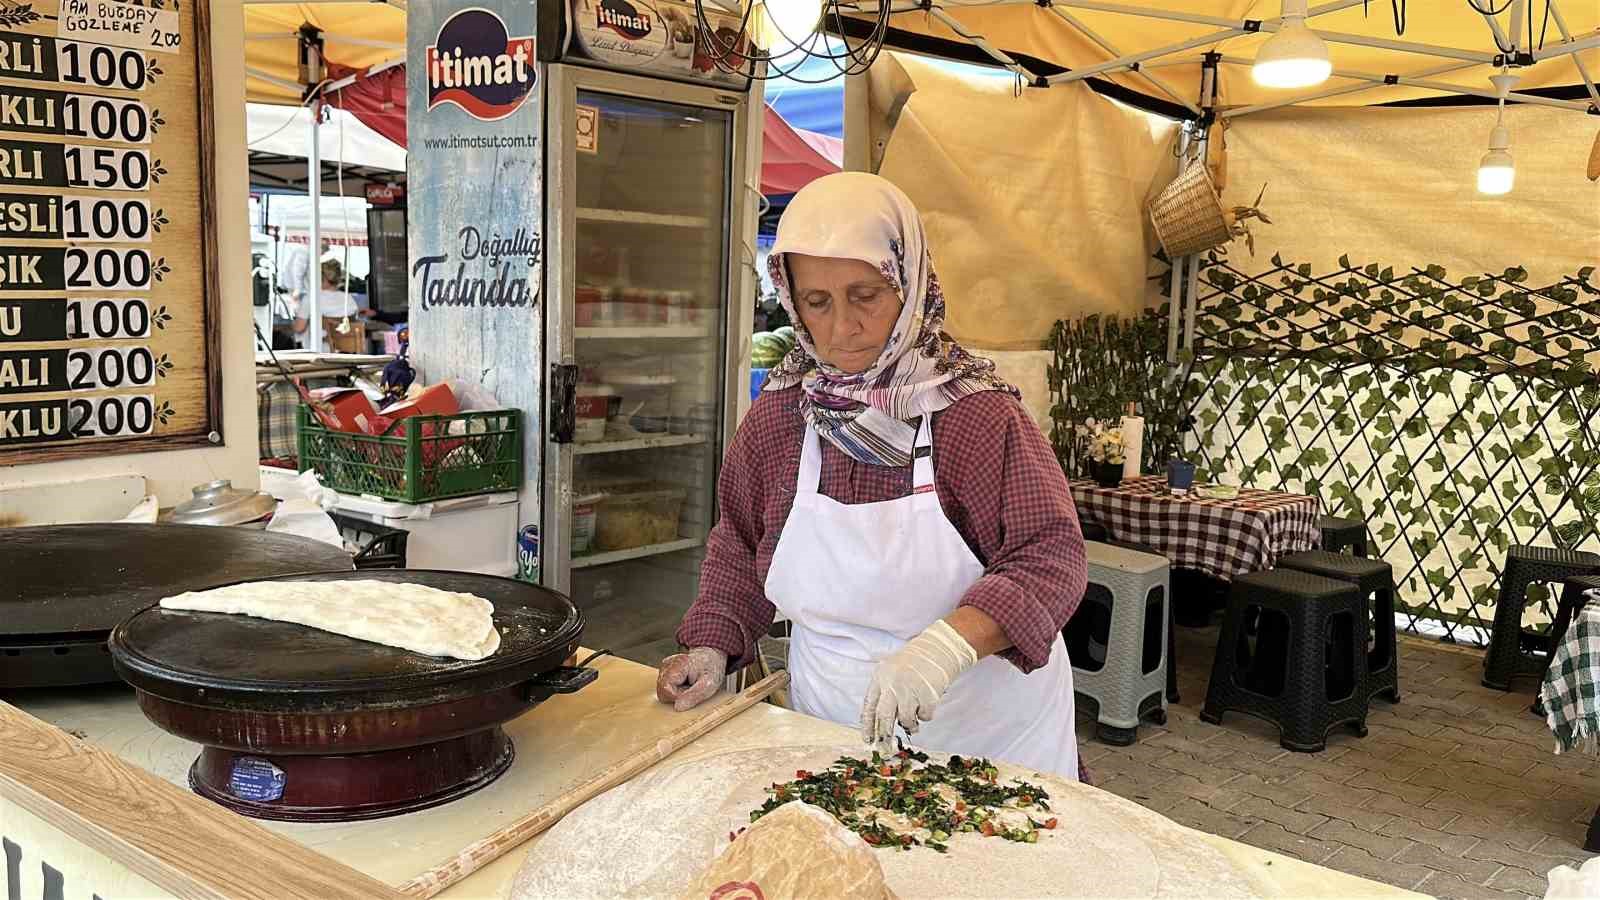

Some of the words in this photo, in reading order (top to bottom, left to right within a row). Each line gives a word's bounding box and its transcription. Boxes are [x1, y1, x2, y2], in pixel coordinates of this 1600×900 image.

[66, 16, 144, 33] GÖZLEME
[151, 29, 181, 47] 200
[599, 7, 649, 31] itimat
[62, 43, 145, 89] 100
[432, 45, 528, 88] itimat
[65, 97, 147, 142] 100
[425, 134, 537, 149] www.itimatsut.com.tr
[65, 148, 149, 189] 150
[65, 200, 149, 239] 100
[66, 249, 150, 287] 200
[67, 300, 149, 339] 100
[69, 348, 153, 389] 200
[68, 397, 152, 436] 200
